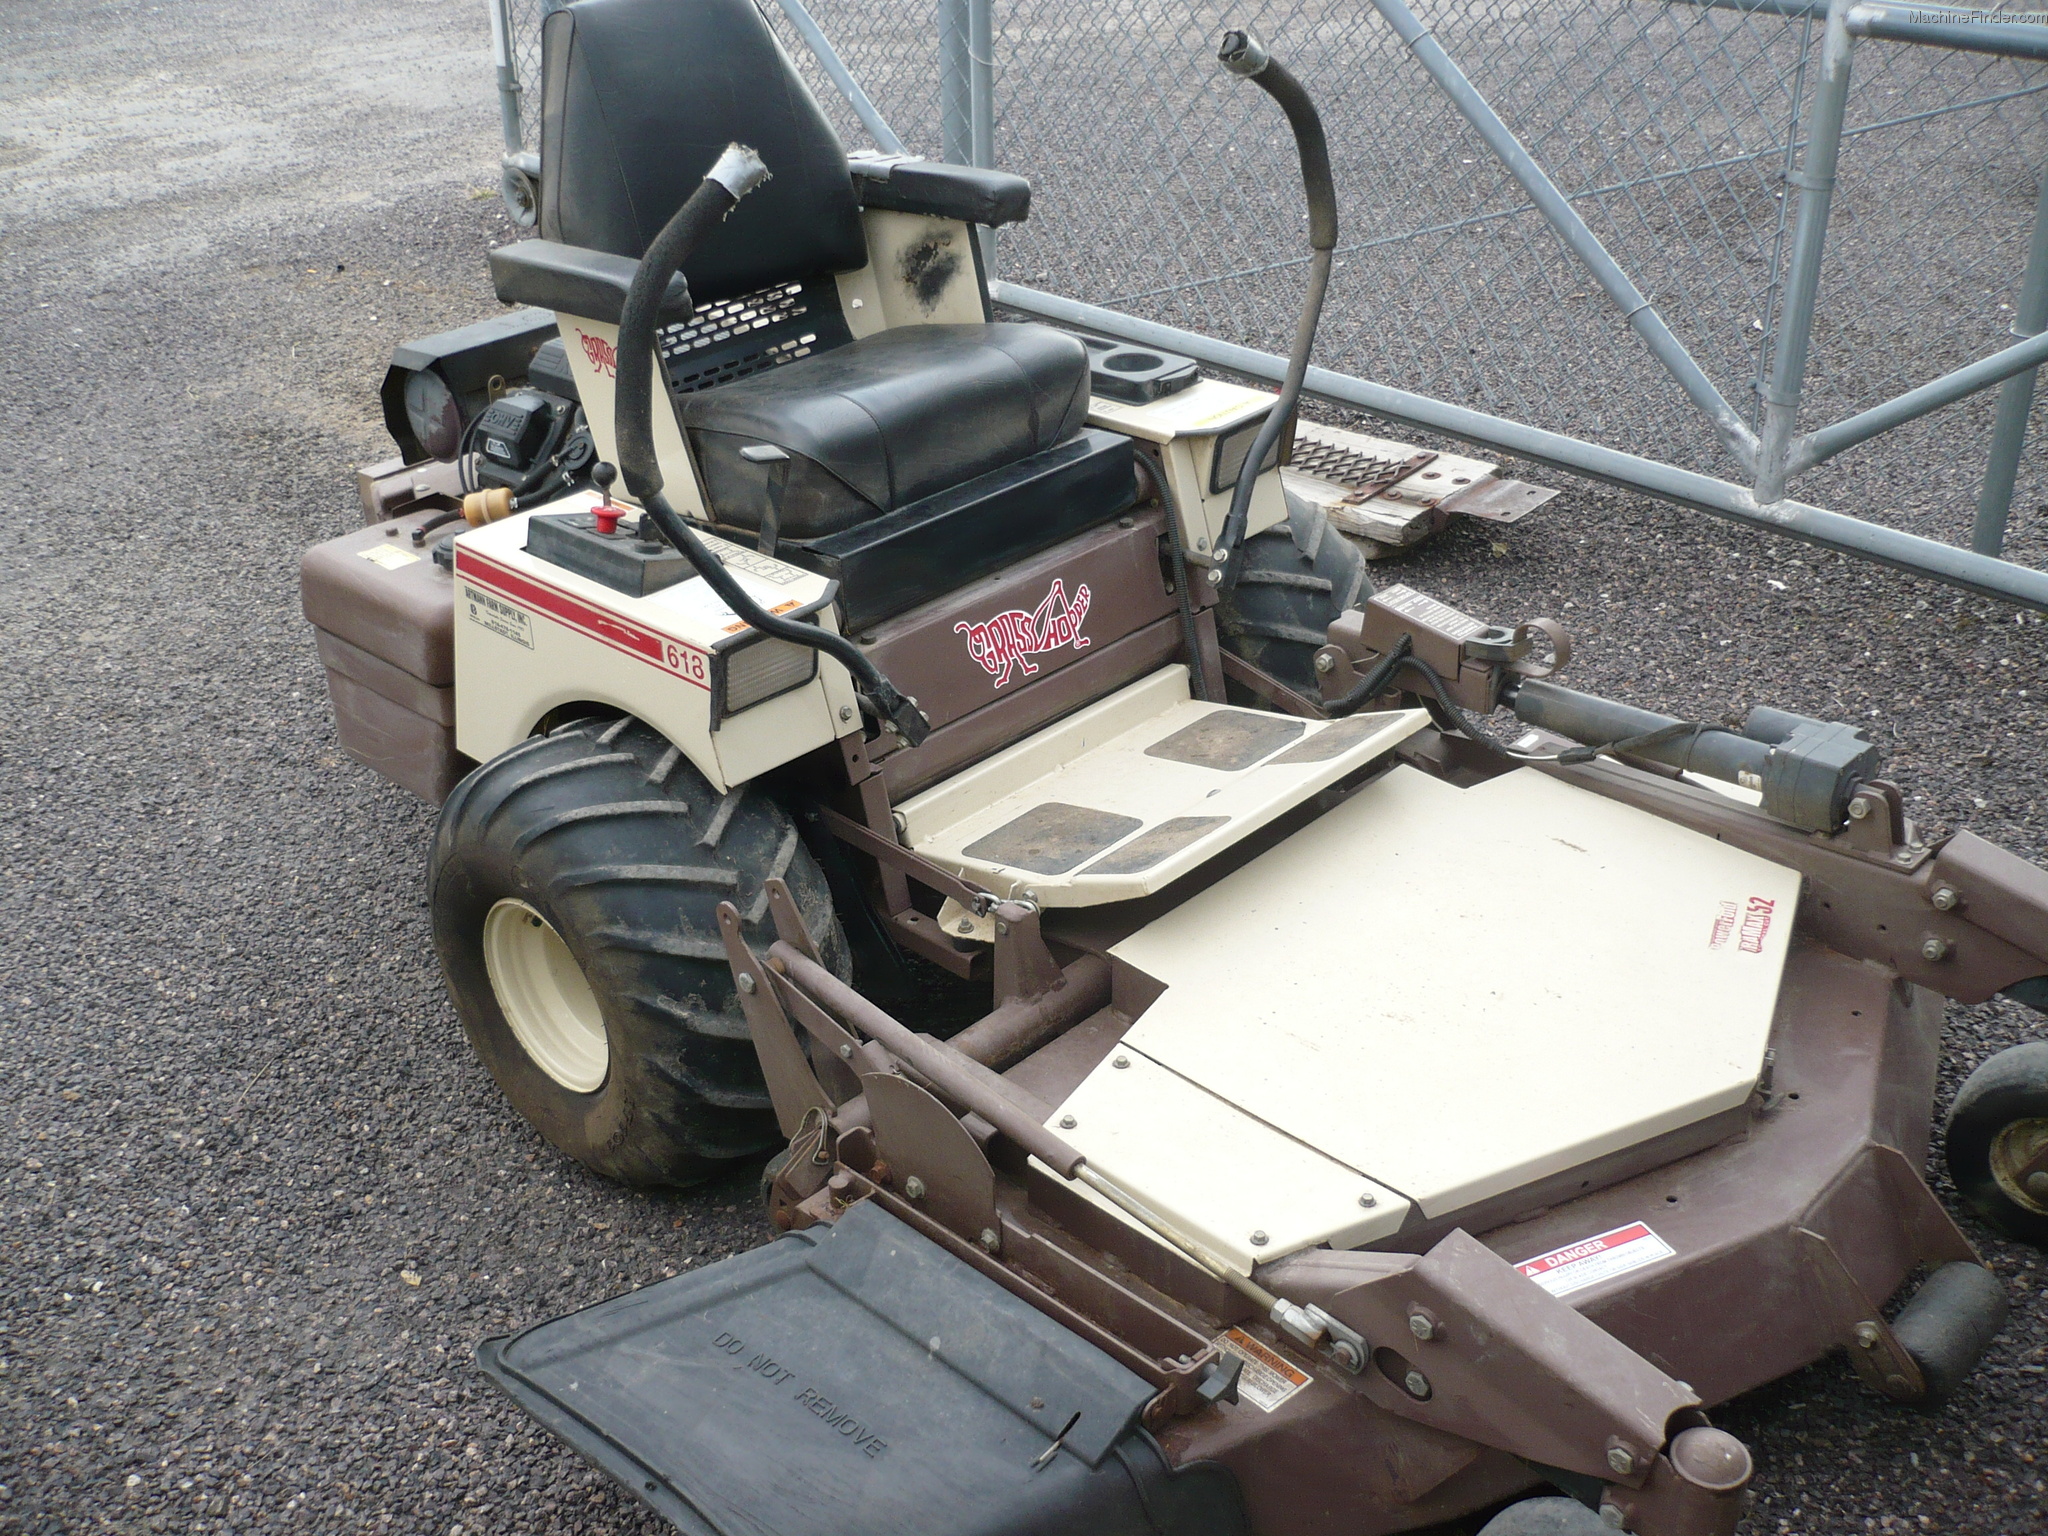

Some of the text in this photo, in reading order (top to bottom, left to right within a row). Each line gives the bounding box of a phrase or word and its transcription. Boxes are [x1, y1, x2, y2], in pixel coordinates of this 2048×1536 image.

[667, 644, 705, 680] 618
[1746, 896, 1775, 914] 52
[1544, 1239, 1608, 1268] DANGER
[1556, 1261, 1577, 1275] KEEP
[1246, 1341, 1295, 1378] WARNING
[712, 1332, 888, 1459] DO NOT REMOVE
